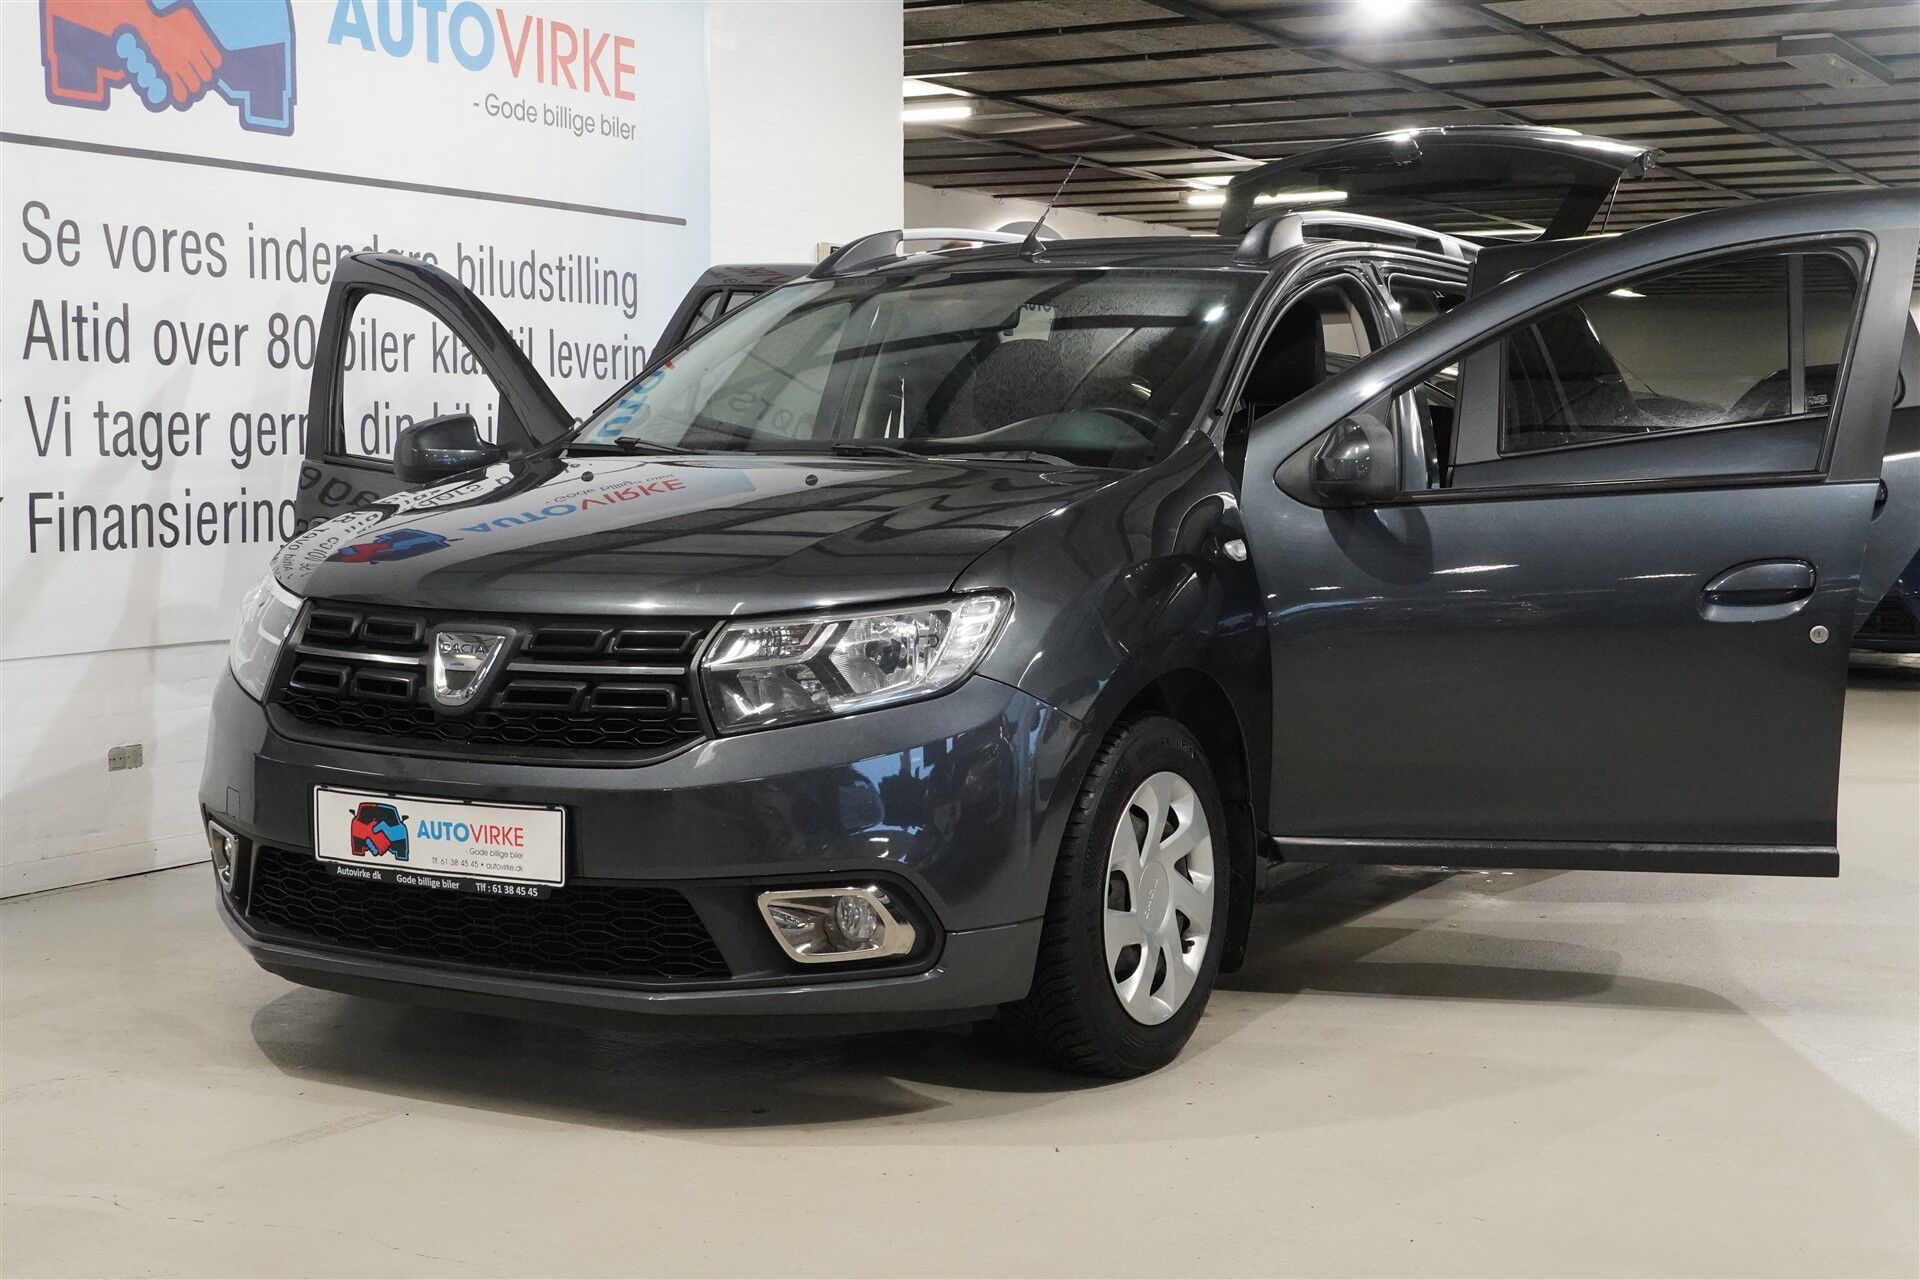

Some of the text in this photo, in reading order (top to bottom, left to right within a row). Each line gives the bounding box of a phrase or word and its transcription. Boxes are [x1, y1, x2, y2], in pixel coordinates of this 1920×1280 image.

[328, 0, 635, 102] AUTOVIRKE
[485, 93, 537, 123] Gode
[543, 103, 595, 137] billige
[600, 114, 636, 141] biler
[22, 200, 80, 267] Se
[103, 223, 227, 278] vores
[457, 242, 638, 319] biludstilling
[22, 299, 130, 364] Altid
[154, 319, 249, 367] over
[267, 312, 316, 370] 80
[432, 321, 487, 375] kla
[509, 326, 533, 363] il
[549, 328, 646, 380] leverin
[24, 396, 72, 457] Vi
[93, 400, 211, 471] tager
[229, 411, 310, 470] gern
[440, 641, 489, 655] DACIA
[417, 819, 524, 847] AUTOVIRKE
[461, 859, 469, 867] 45
[470, 860, 479, 868] 45
[486, 863, 523, 872] autovirke.dk
[469, 848, 488, 856] Gode
[490, 850, 508, 859] billige
[396, 874, 416, 885] Gode
[417, 877, 440, 888] billige
[441, 879, 460, 889] biler
[492, 884, 503, 894] 61
[504, 885, 514, 895] 38
[515, 886, 526, 896] 45
[527, 888, 538, 897] 45
